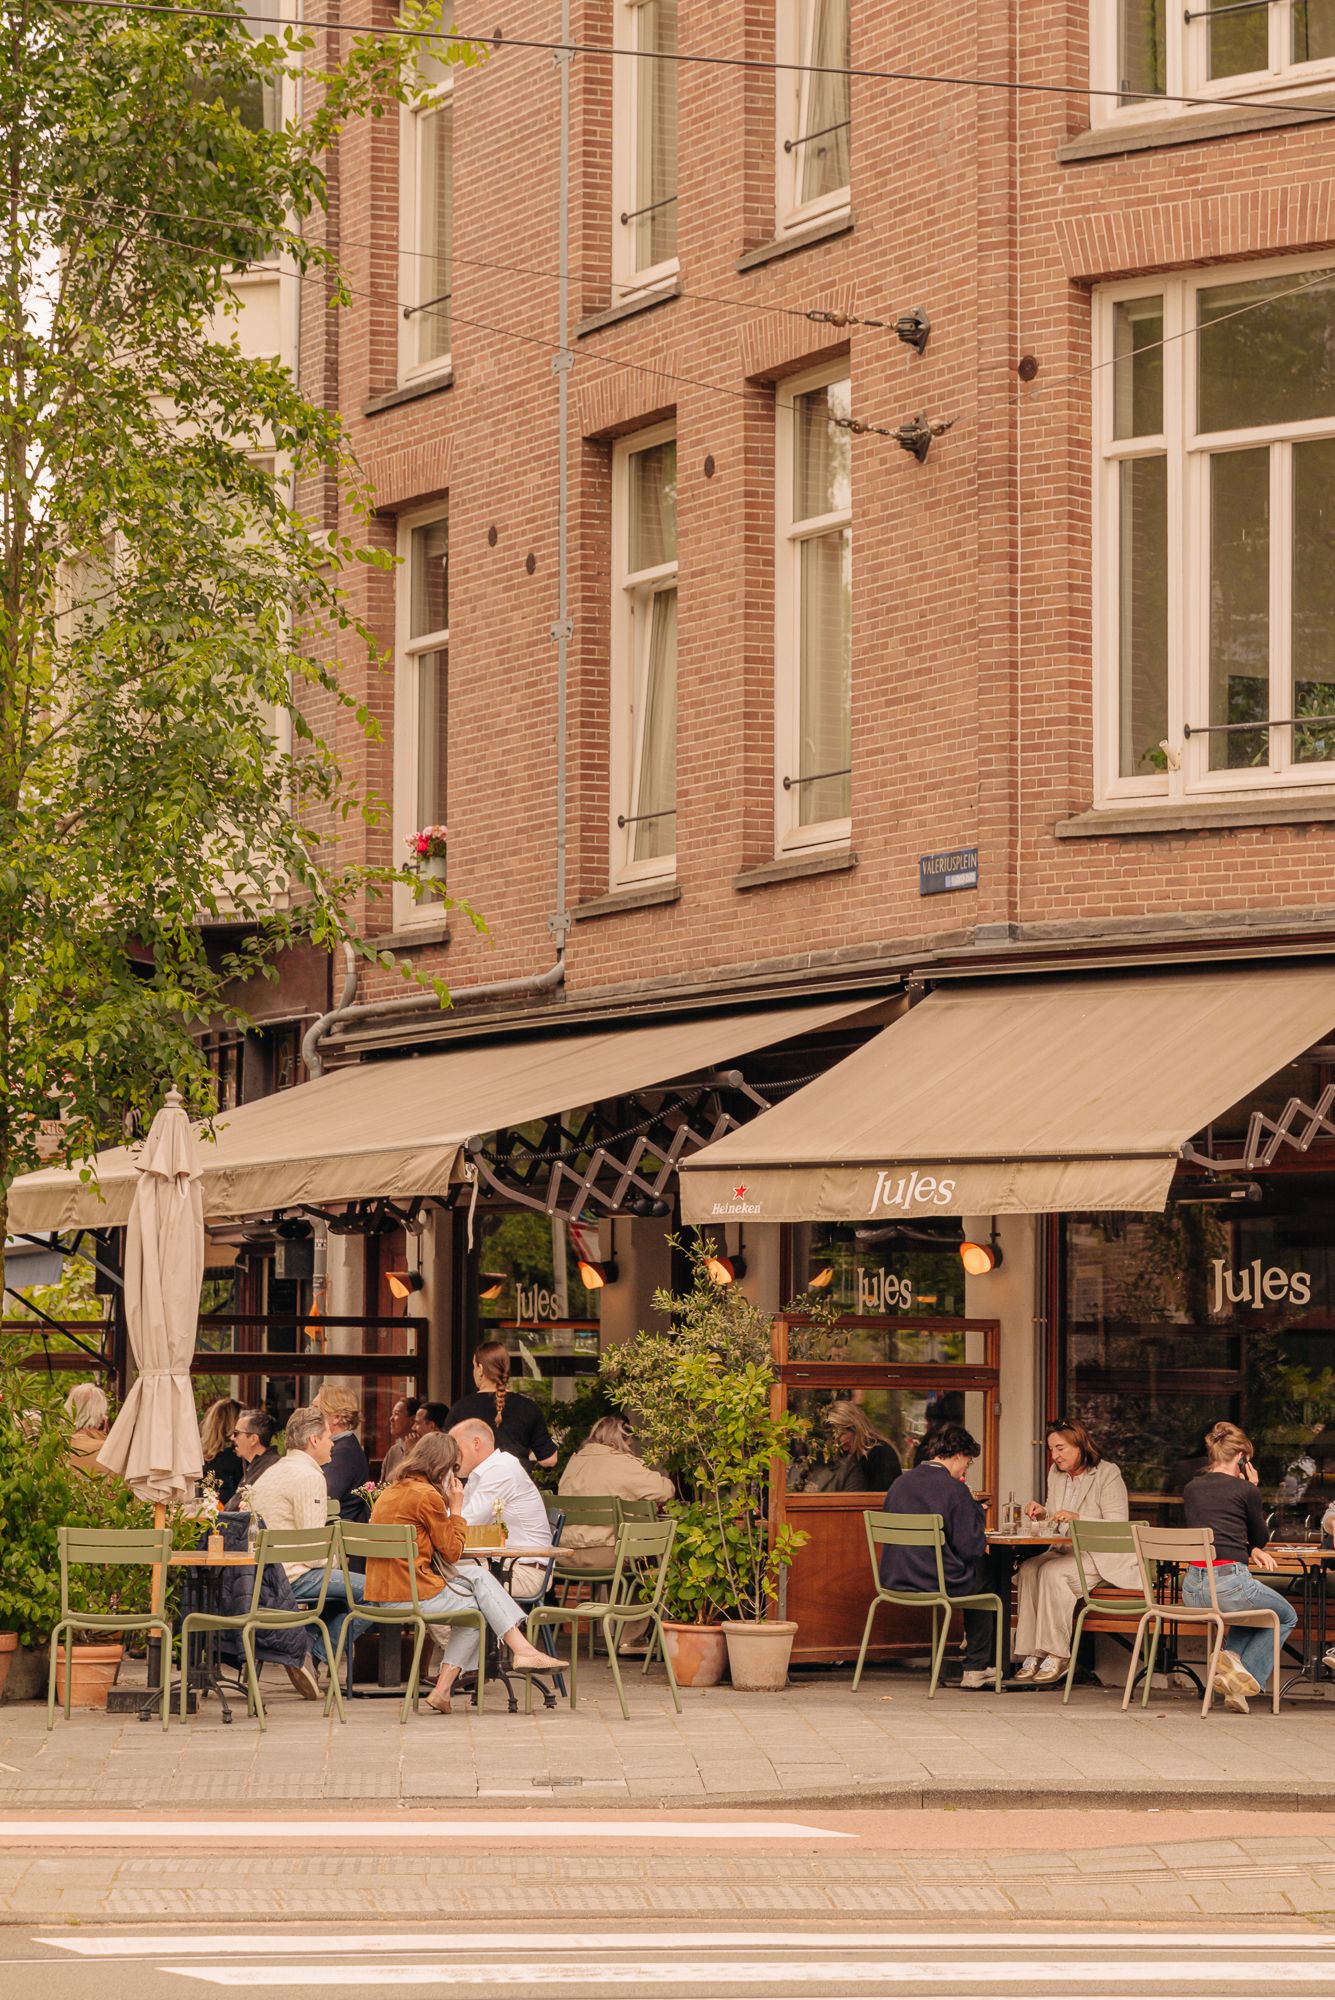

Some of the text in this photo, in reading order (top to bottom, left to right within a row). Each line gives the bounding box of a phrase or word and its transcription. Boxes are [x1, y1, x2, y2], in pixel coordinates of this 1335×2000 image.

[922, 853, 977, 875] VALERIUSPLEIN
[712, 1202, 761, 1215] Heineken
[868, 1170, 956, 1215] Jules
[515, 1282, 560, 1327] Jules
[857, 1267, 912, 1315] Jules
[1212, 1259, 1311, 1313] Jules
